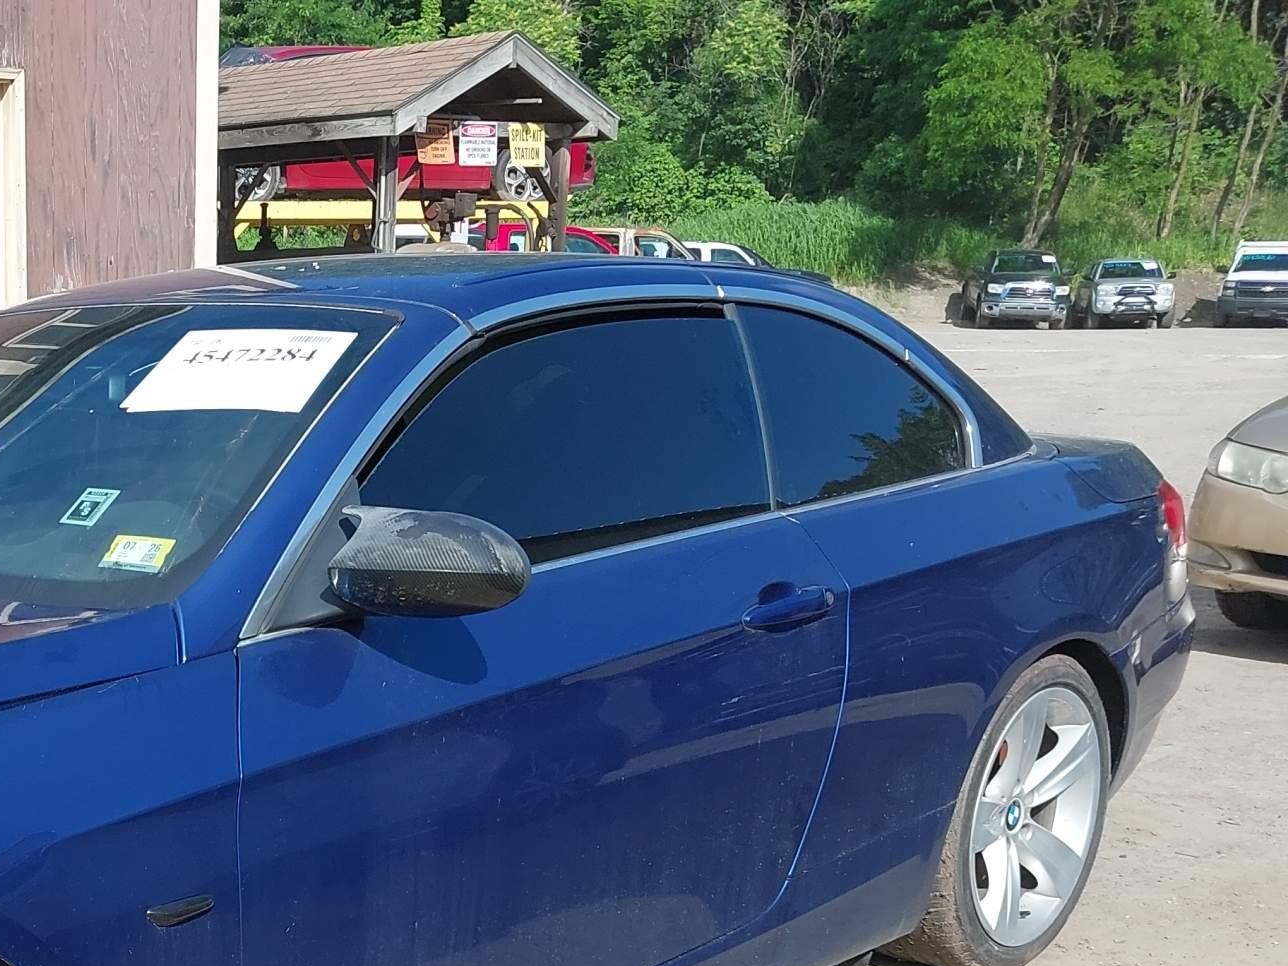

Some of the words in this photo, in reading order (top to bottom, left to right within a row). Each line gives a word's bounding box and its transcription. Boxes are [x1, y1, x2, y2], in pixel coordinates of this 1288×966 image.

[514, 147, 540, 160] STATION
[183, 348, 318, 364] 45472284
[123, 541, 137, 551] 07
[148, 544, 162, 553] 26
